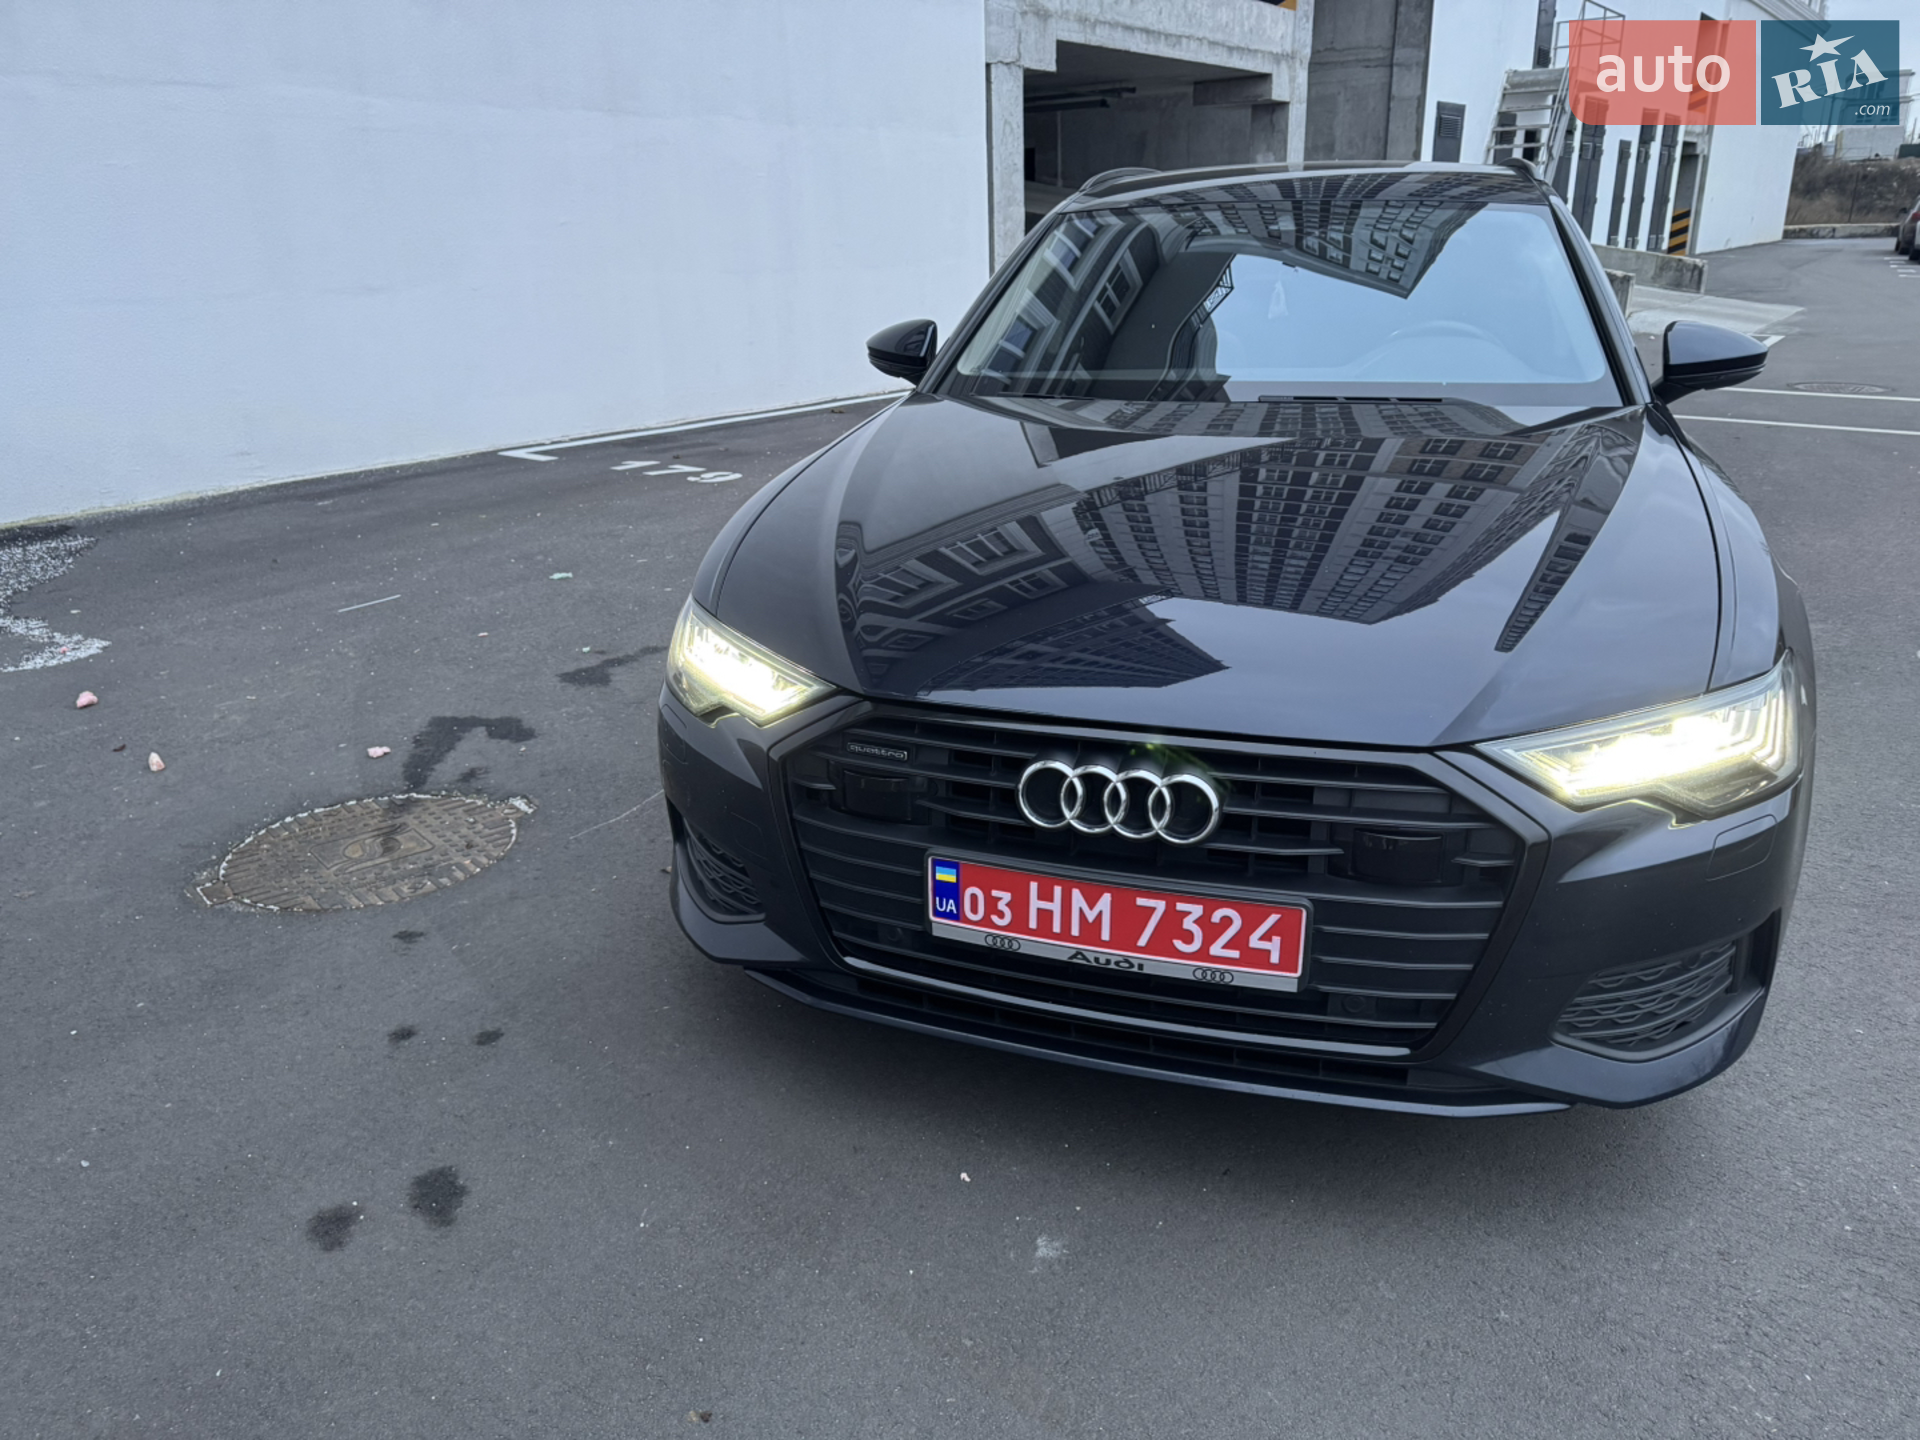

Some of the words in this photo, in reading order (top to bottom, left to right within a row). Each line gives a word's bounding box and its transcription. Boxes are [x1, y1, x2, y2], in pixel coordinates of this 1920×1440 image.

[850, 744, 905, 759] quattro
[935, 896, 957, 915] UA
[963, 885, 1012, 927] 03
[1028, 880, 1112, 942] HM
[1135, 896, 1283, 965] 7324
[1067, 950, 1145, 972] Audi
